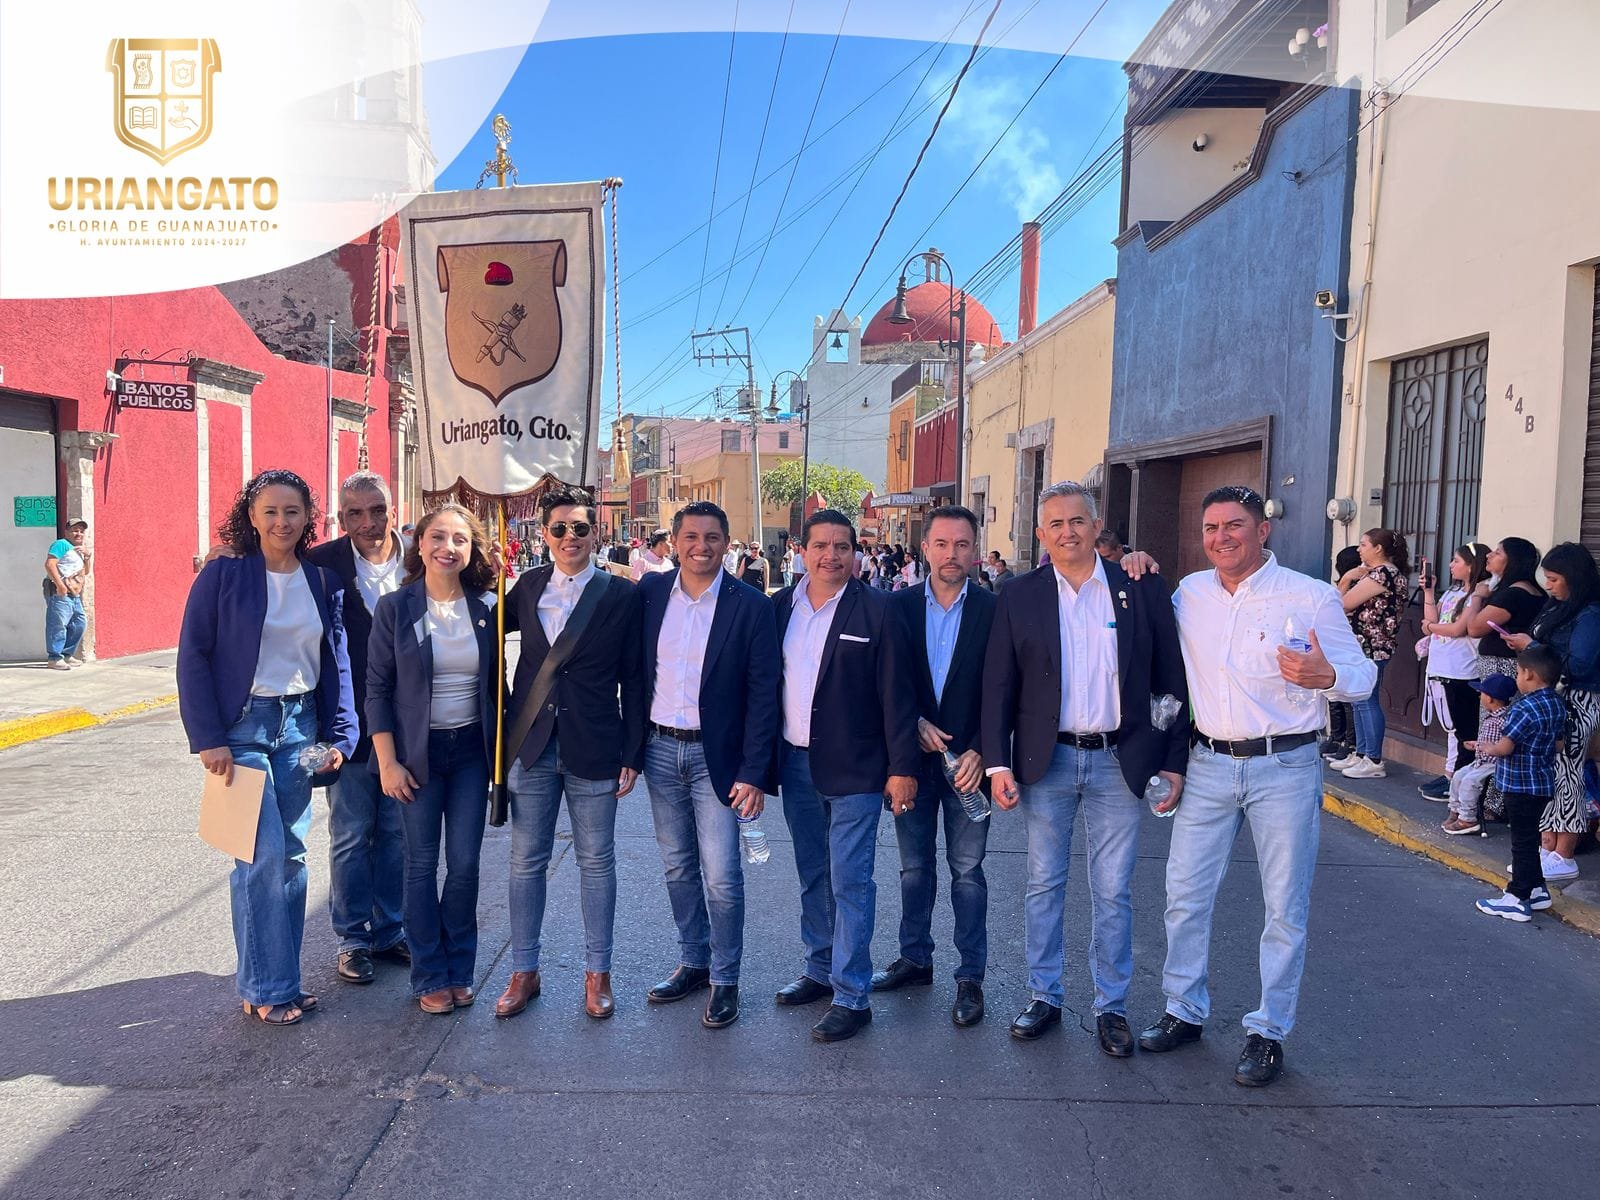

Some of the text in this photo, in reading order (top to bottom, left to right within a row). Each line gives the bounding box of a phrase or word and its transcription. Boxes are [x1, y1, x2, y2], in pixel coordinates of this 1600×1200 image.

[118, 394, 193, 410] PUBLICOS
[441, 413, 572, 445] Uriangato, Gto.
